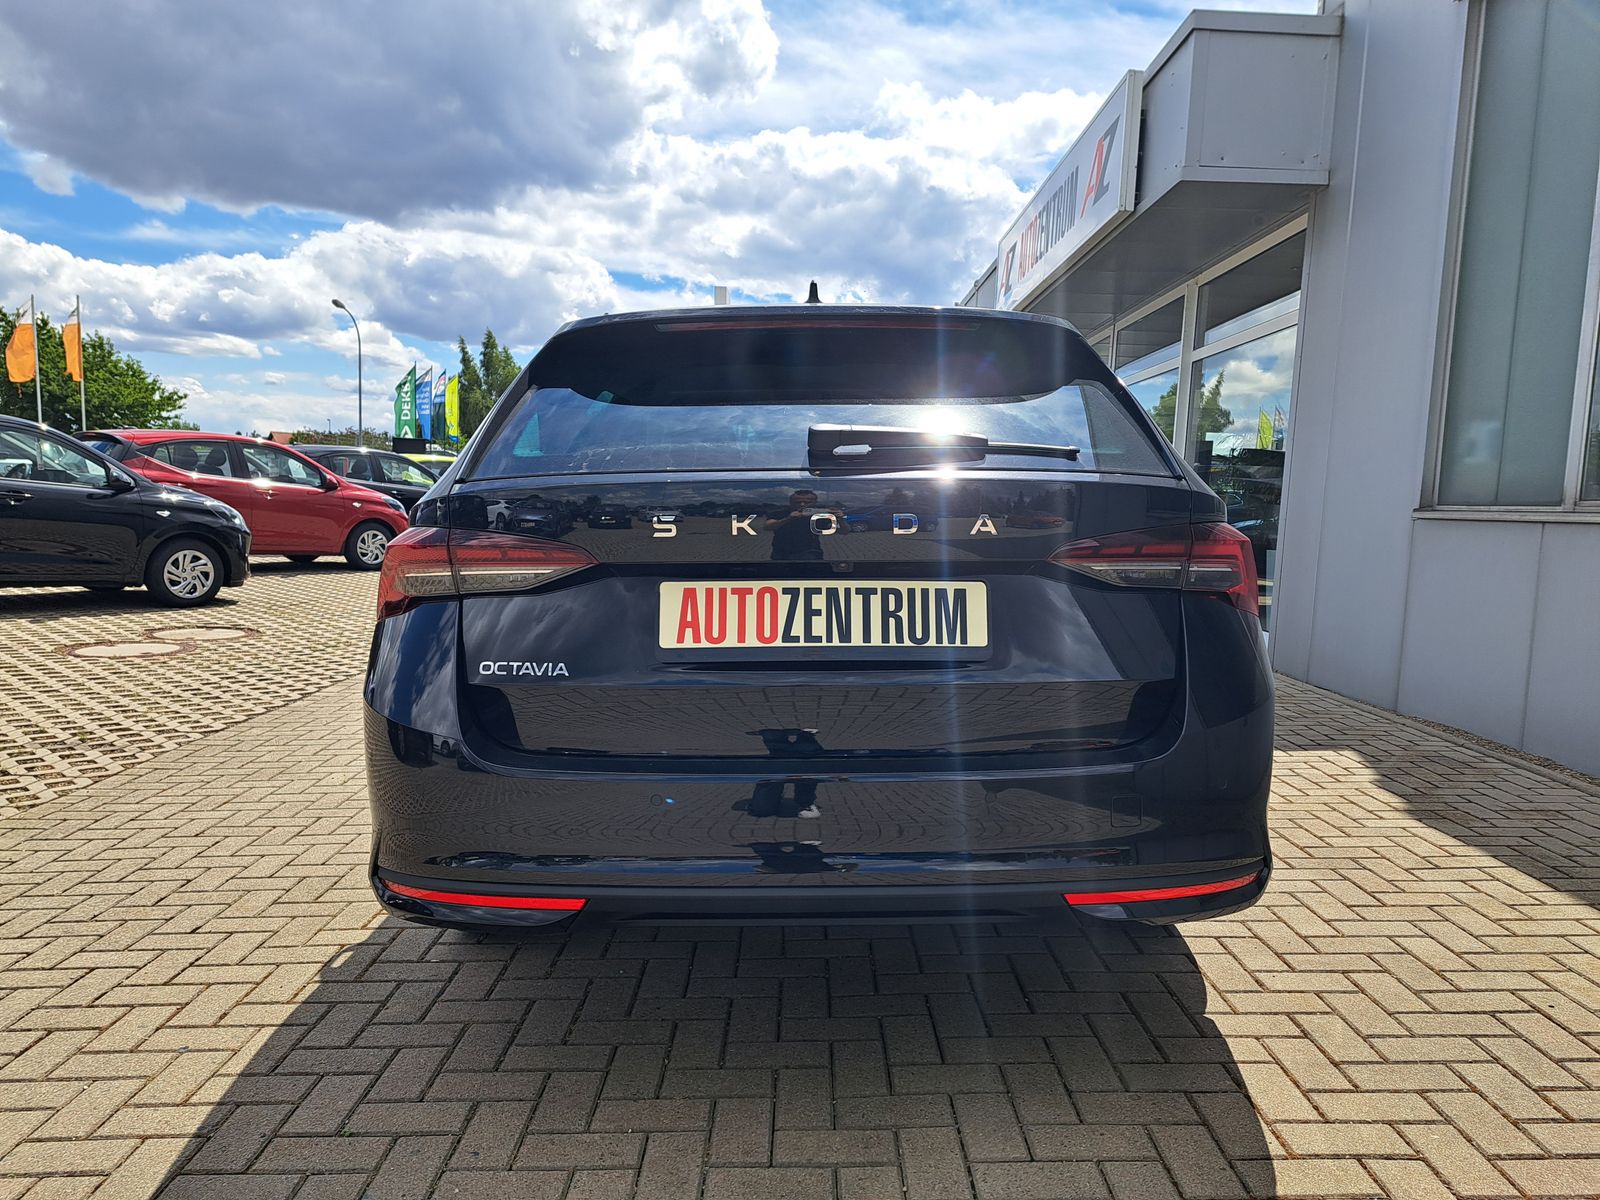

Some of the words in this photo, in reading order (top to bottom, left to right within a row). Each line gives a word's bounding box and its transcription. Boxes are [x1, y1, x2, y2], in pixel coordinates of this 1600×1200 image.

[998, 240, 1017, 301] AZ
[1018, 165, 1079, 282] AUTOZENTRUM
[1080, 113, 1121, 219] AZ
[401, 375, 411, 420] DEKR
[652, 513, 999, 538] SKODA
[676, 586, 969, 646] AUTOZENTRUM
[479, 661, 569, 677] OCTAVIA
